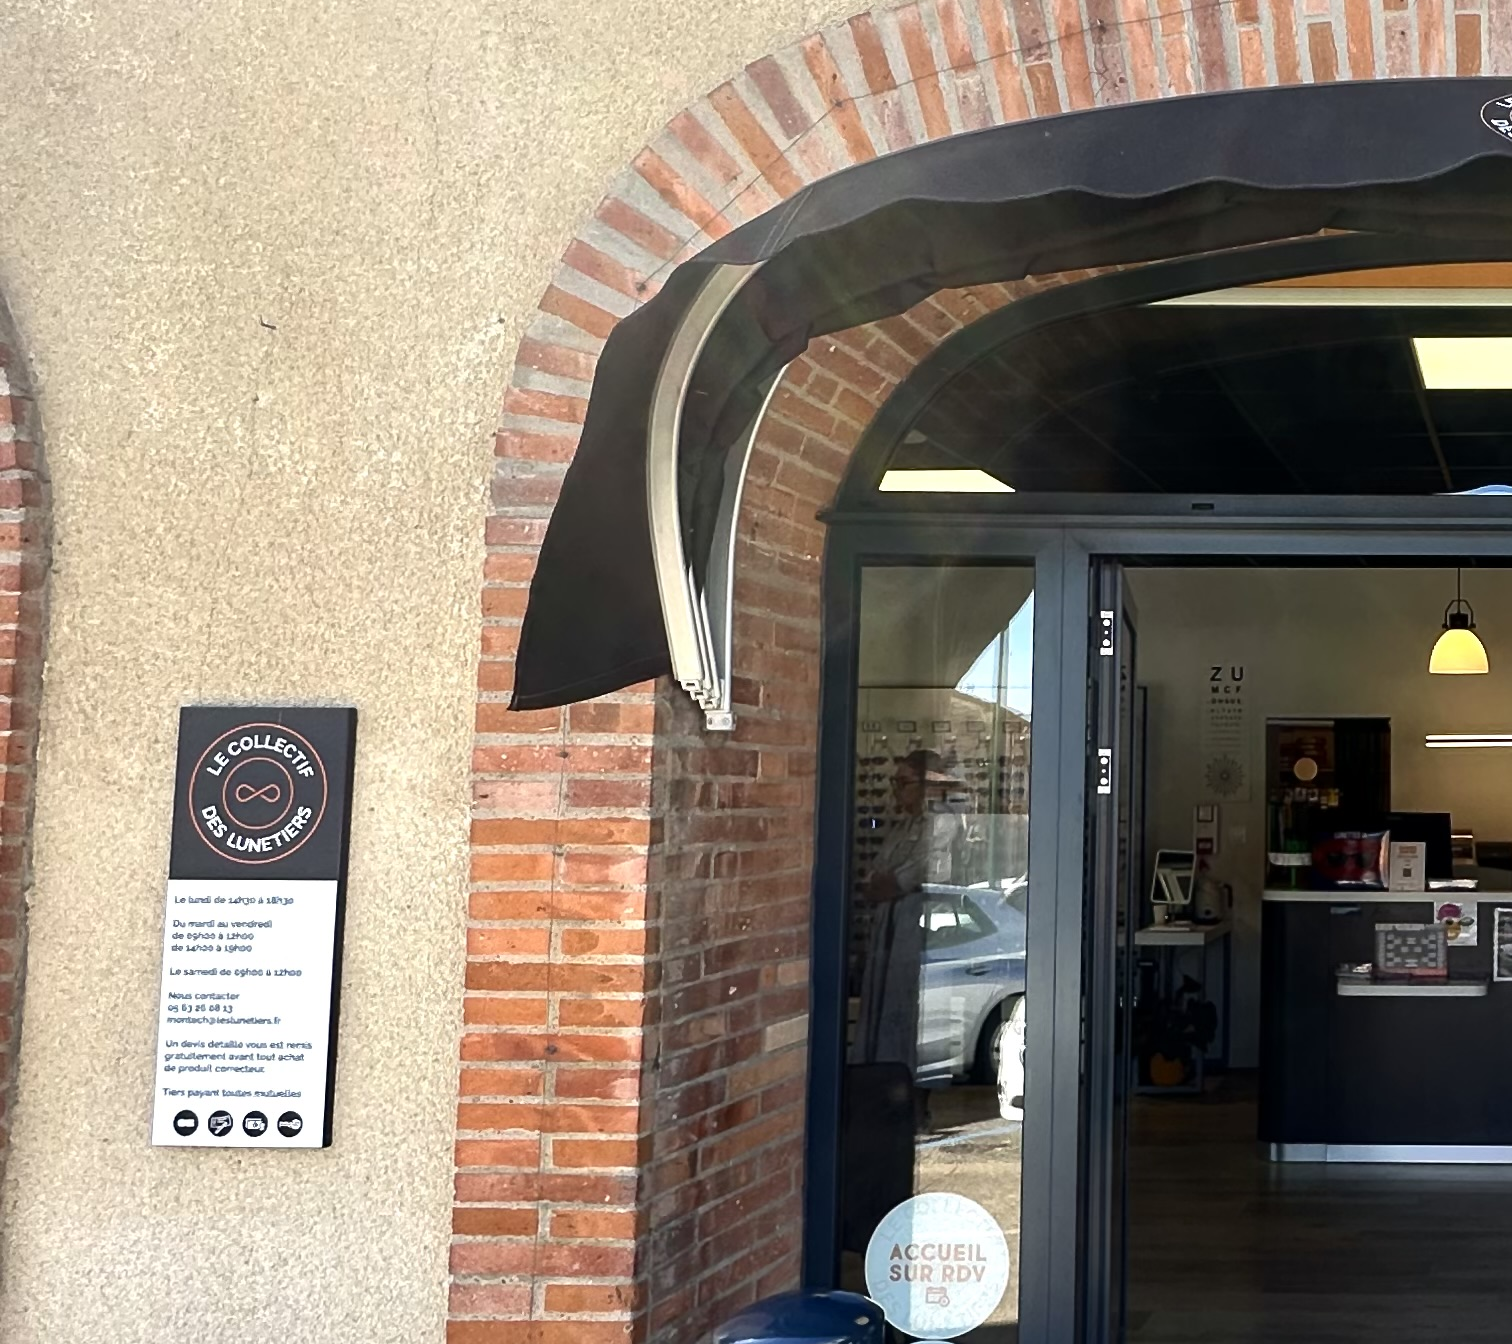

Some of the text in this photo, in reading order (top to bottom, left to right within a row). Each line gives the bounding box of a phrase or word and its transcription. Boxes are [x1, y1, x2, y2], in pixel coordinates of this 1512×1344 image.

[1210, 666, 1244, 682] Z U
[206, 734, 315, 778] LE COLLECTIF
[201, 805, 313, 853] DES LUNETIERS
[174, 896, 185, 904] Le
[188, 895, 211, 904] lundi
[214, 896, 226, 904] de
[173, 920, 186, 928] Du
[188, 919, 215, 928] mardi
[231, 919, 272, 928] vendredi
[172, 932, 184, 940] de
[170, 967, 182, 975] Le
[183, 967, 217, 976] samedi
[220, 968, 231, 976] de
[168, 992, 240, 1000] Nous contacter
[165, 1040, 178, 1048] Un
[181, 1039, 205, 1048] devis
[245, 1041, 267, 1049] vous
[270, 1041, 284, 1049] est
[286, 1040, 313, 1049] remis
[164, 1052, 305, 1061] gratuitement avant tout achat
[164, 1064, 176, 1072] de
[178, 1064, 212, 1074] produit
[162, 1088, 301, 1099] Tiers payant toutes mutuelles
[889, 1243, 987, 1262] ACCUEIL
[889, 1263, 986, 1283] SUR RDV
